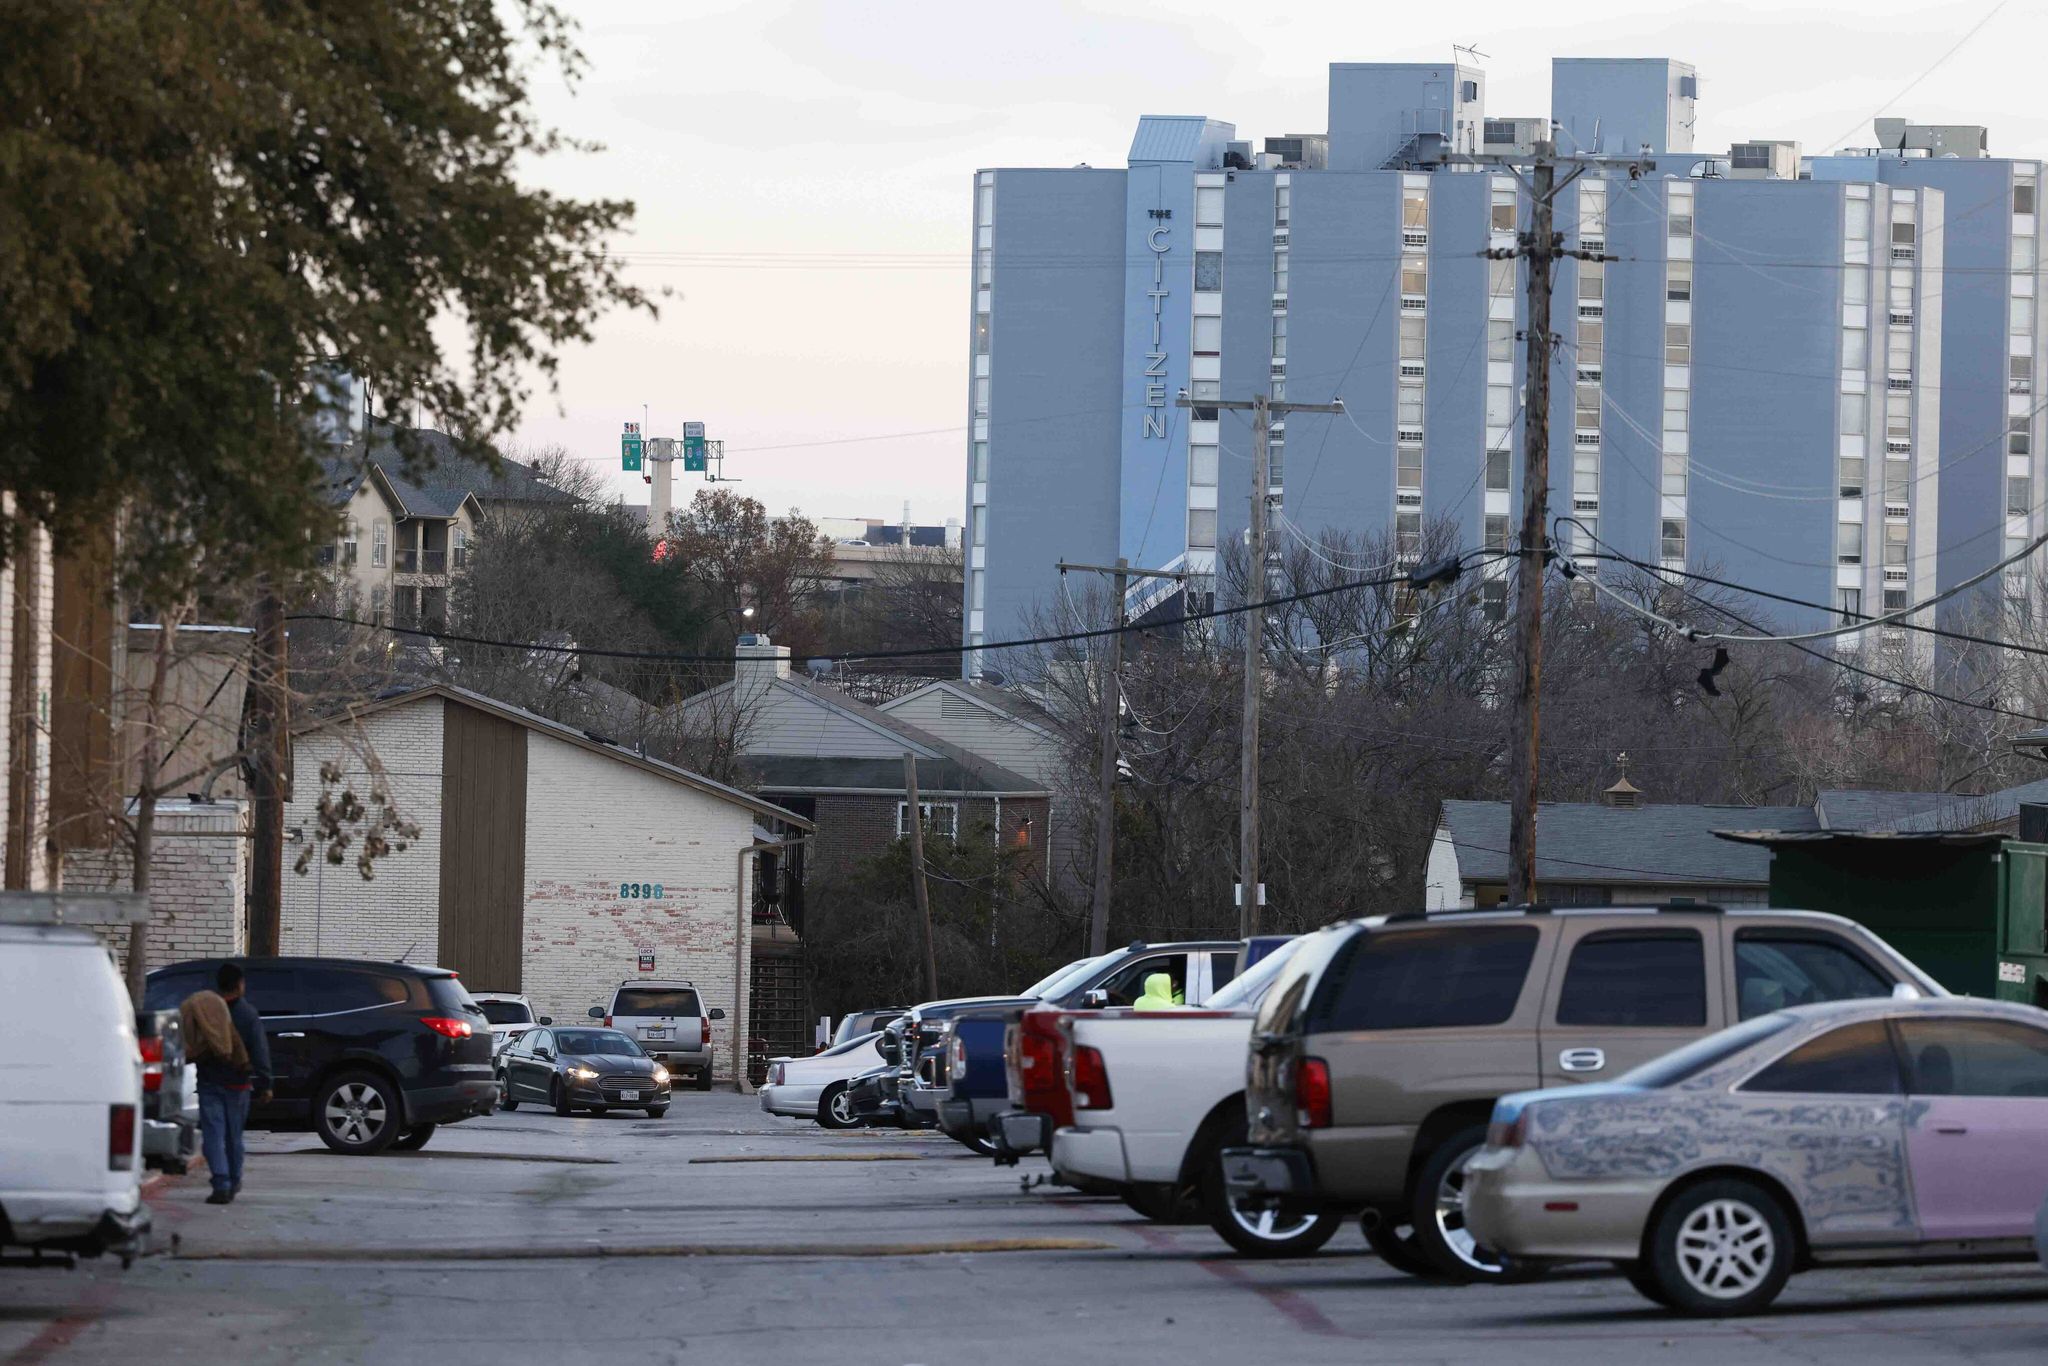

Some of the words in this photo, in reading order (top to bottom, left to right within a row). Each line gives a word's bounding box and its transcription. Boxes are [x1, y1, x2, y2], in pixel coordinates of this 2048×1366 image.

[1148, 209, 1171, 219] THE
[1143, 226, 1171, 438] CITIZEN
[620, 883, 663, 899] 8396
